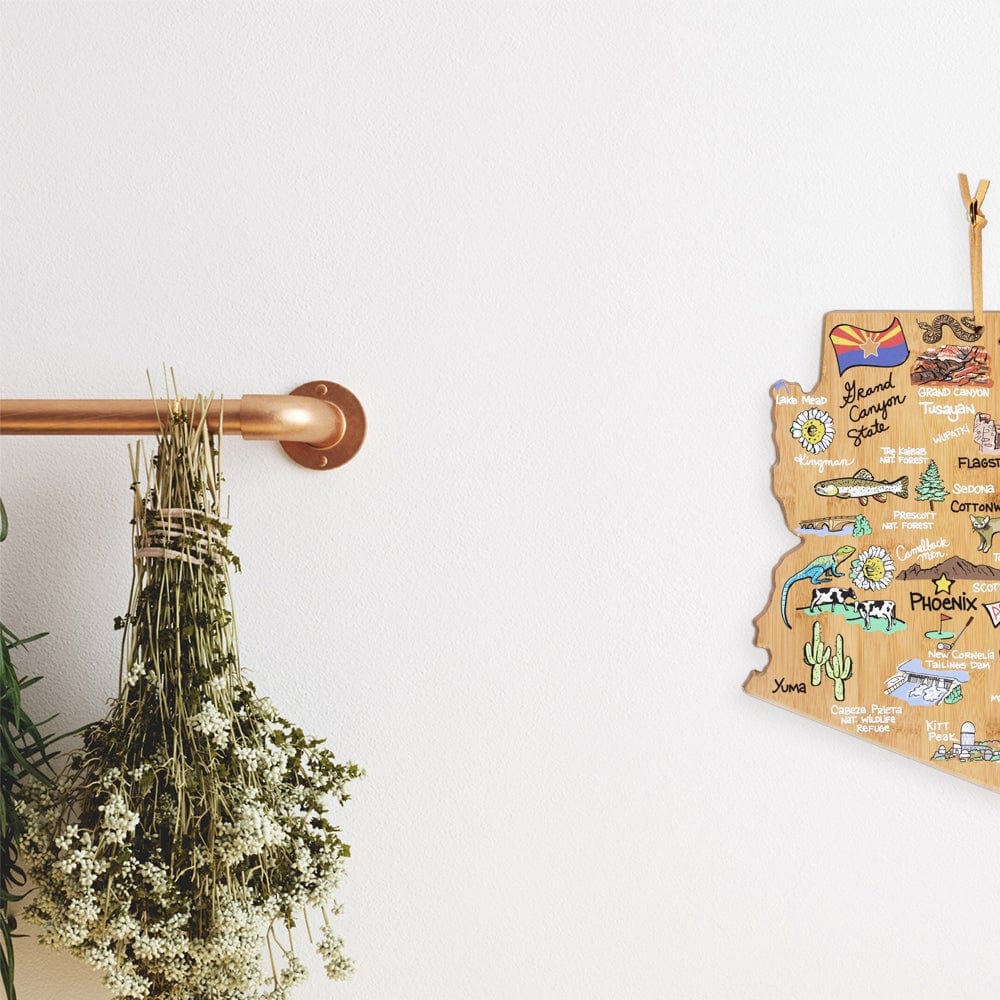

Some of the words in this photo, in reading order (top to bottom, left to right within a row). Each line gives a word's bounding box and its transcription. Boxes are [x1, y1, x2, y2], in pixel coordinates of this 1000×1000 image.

[840, 372, 895, 408] Grand
[849, 395, 906, 423] Canyon
[847, 419, 890, 447] State
[932, 424, 970, 444] WUPATKI
[794, 454, 855, 473] Kingman
[896, 537, 950, 561] Camelback
